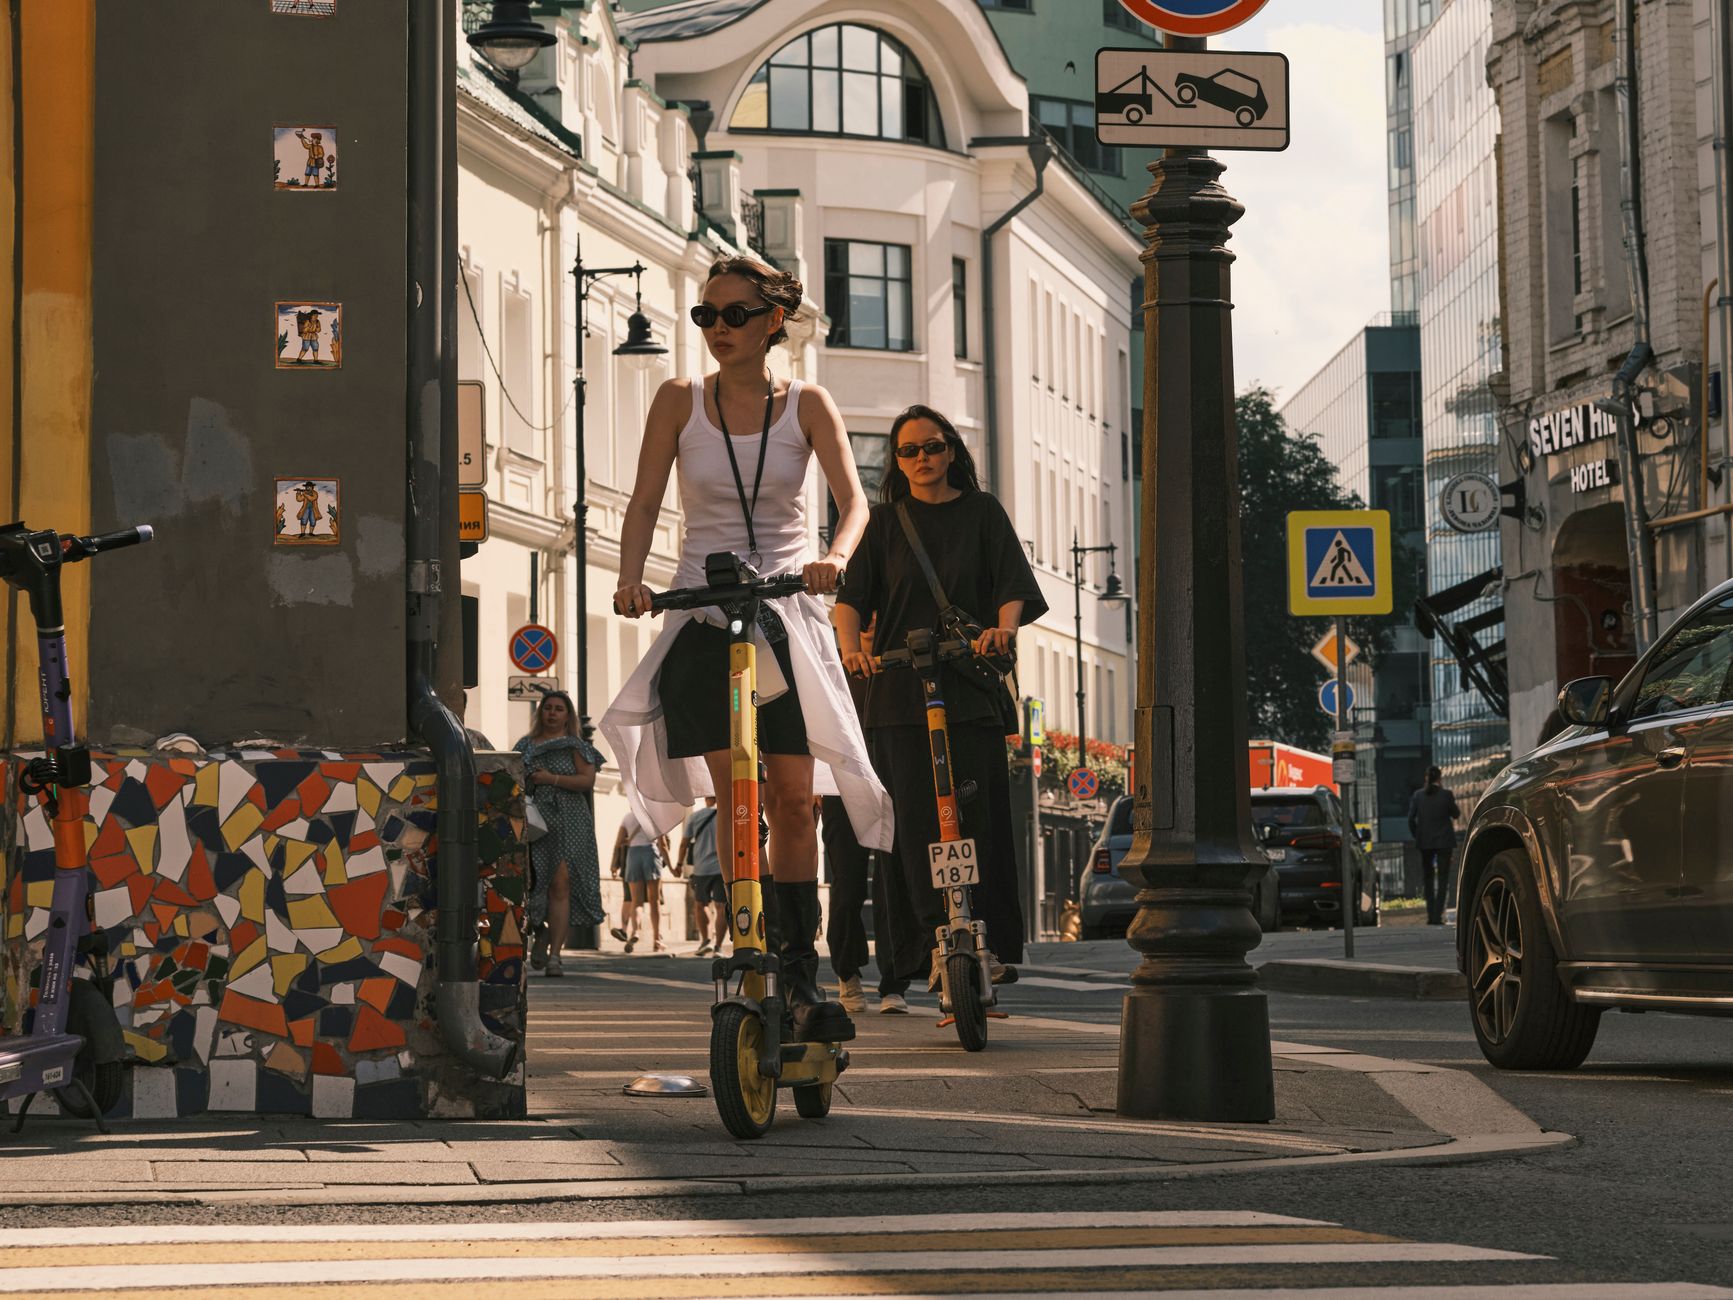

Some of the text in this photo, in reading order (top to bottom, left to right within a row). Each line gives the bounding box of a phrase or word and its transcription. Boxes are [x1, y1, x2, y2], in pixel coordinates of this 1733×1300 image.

[1529, 406, 1585, 457] SEVEN
[1570, 459, 1610, 493] HOTEL
[936, 865, 974, 884] 187
